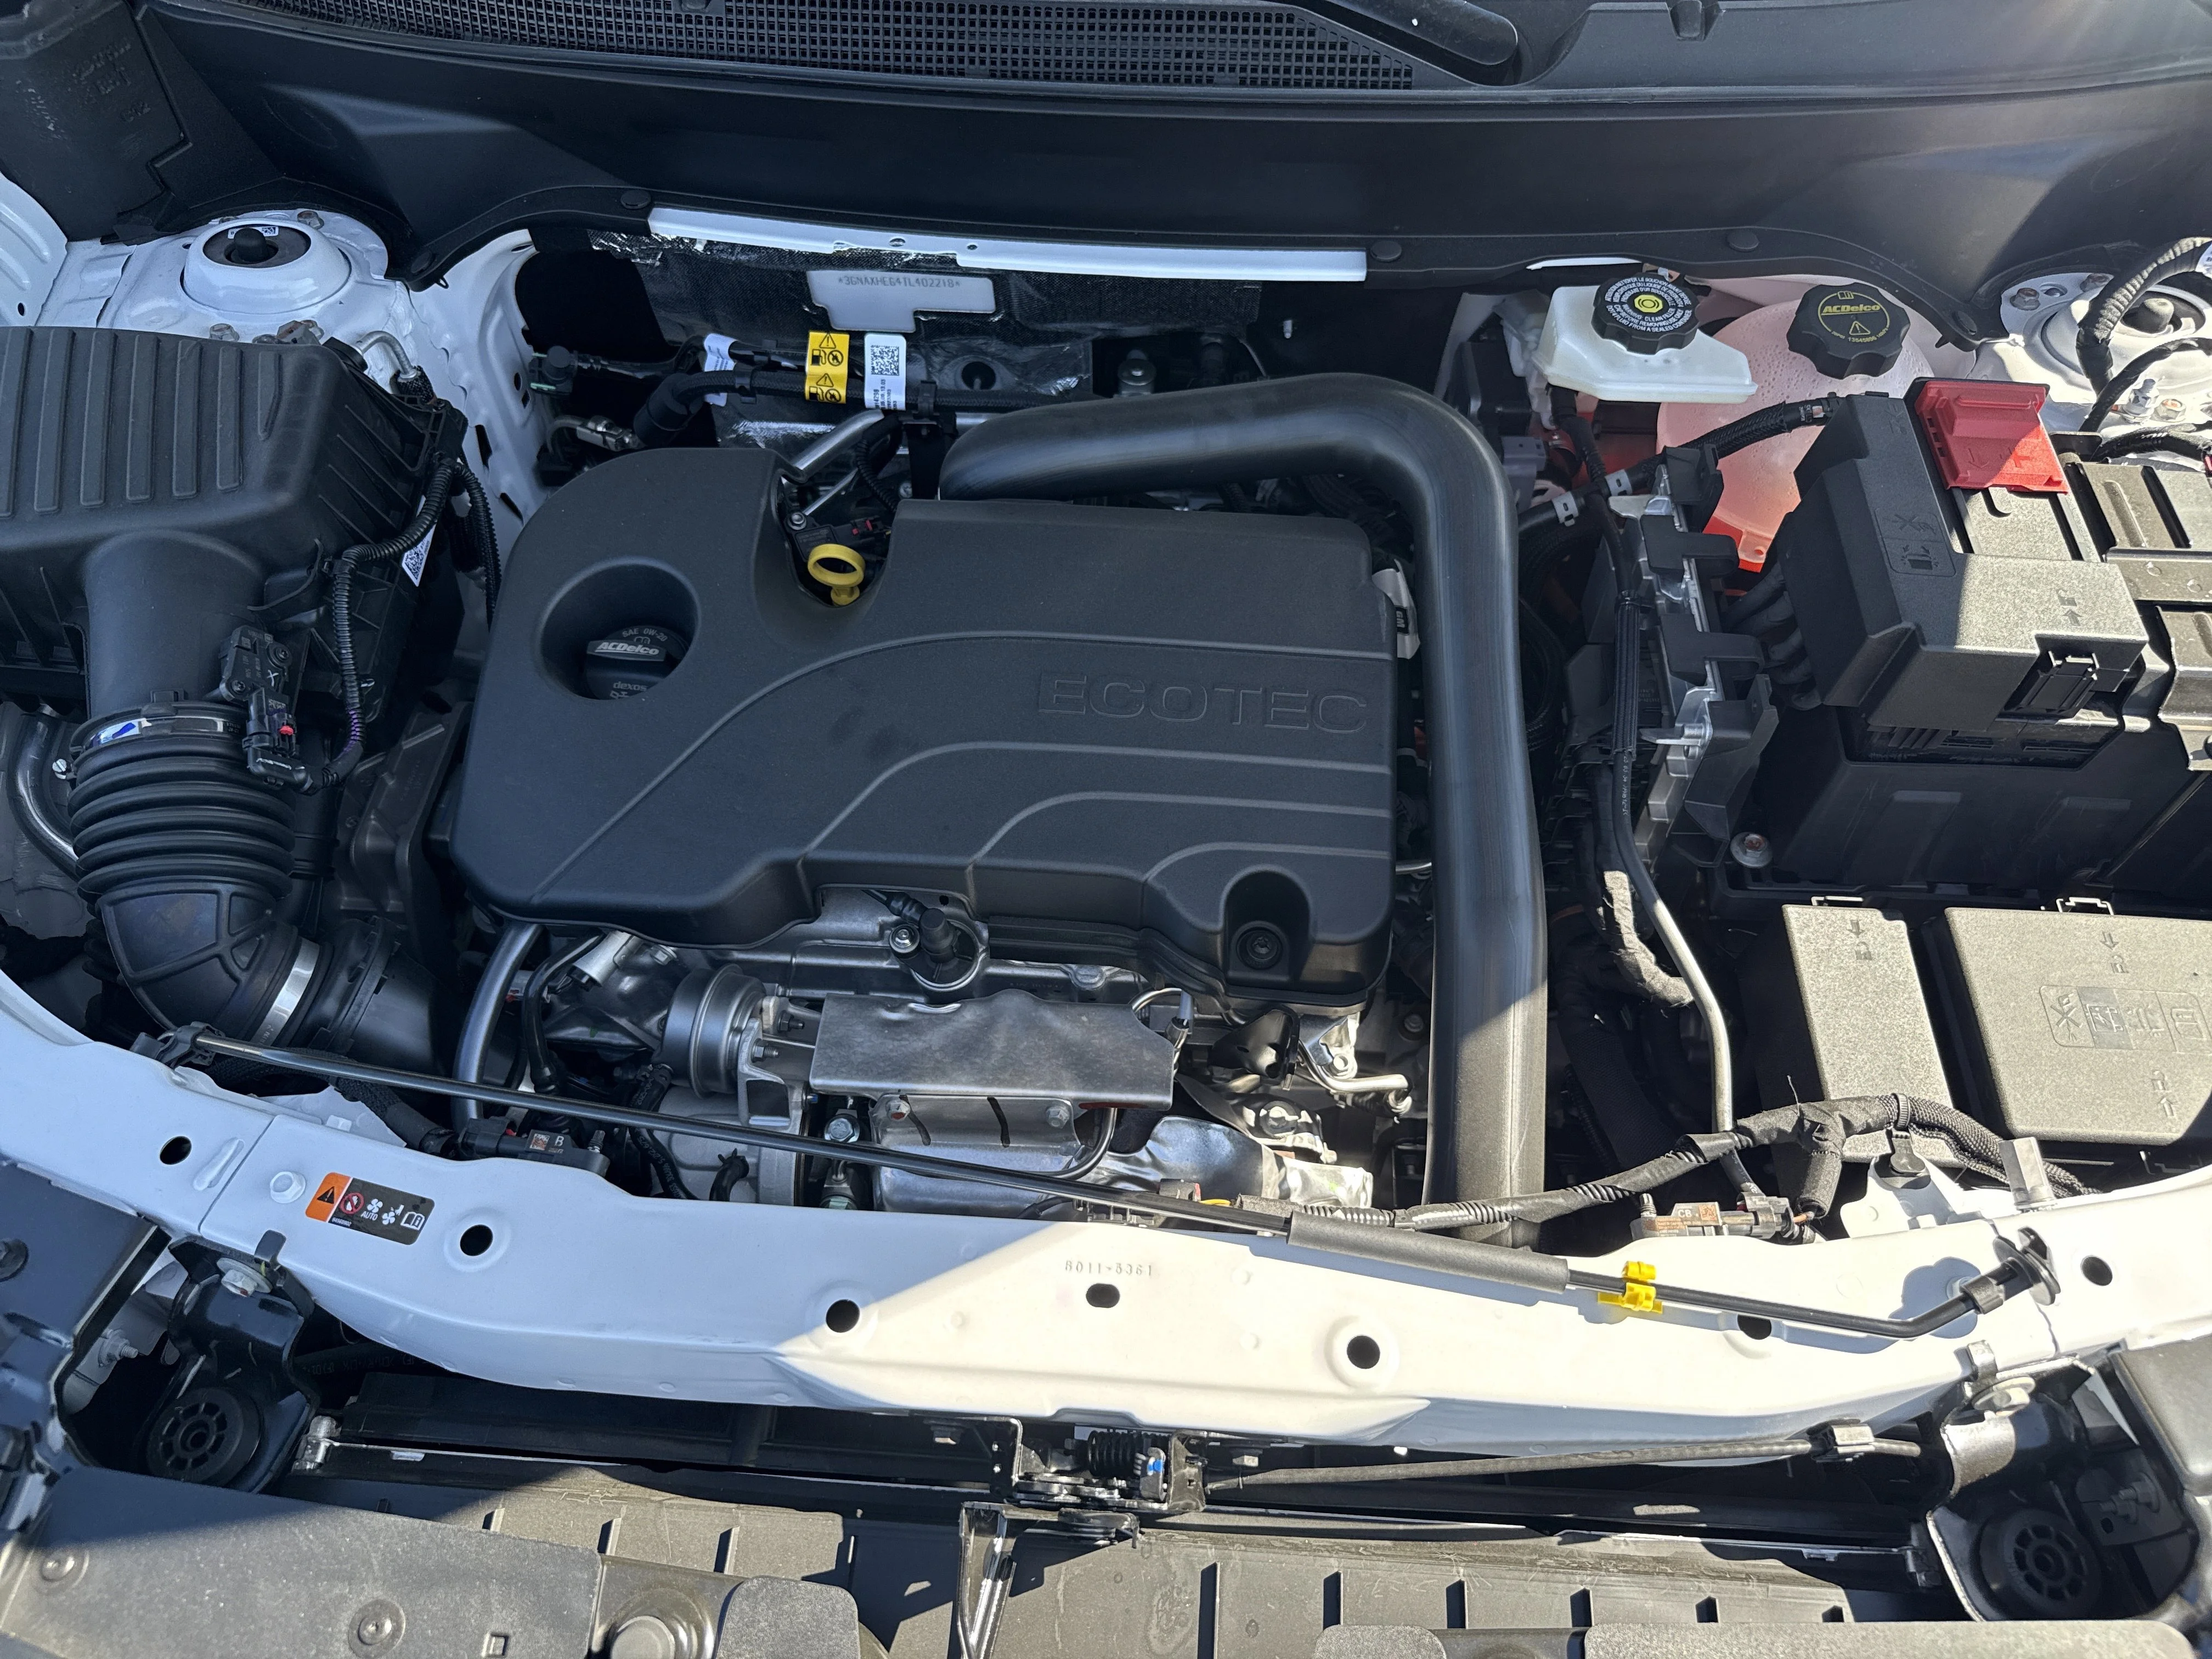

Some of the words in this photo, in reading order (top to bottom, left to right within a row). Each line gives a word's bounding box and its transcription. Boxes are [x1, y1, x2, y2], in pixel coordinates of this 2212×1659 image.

[1822, 304, 1881, 313] ACDelco
[1614, 315, 1629, 325] FLUID
[1628, 323, 1646, 331] FROM
[1396, 610, 1405, 628] GM
[622, 628, 639, 637] SAE
[643, 628, 668, 642] 0W-20
[597, 642, 660, 656] ACDelco
[613, 681, 648, 692] dexos
[1038, 670, 1368, 735] ECOTEC
[554, 1135, 565, 1147] B
[361, 1211, 379, 1222] AUTO
[1678, 1209, 1692, 1218] CB
